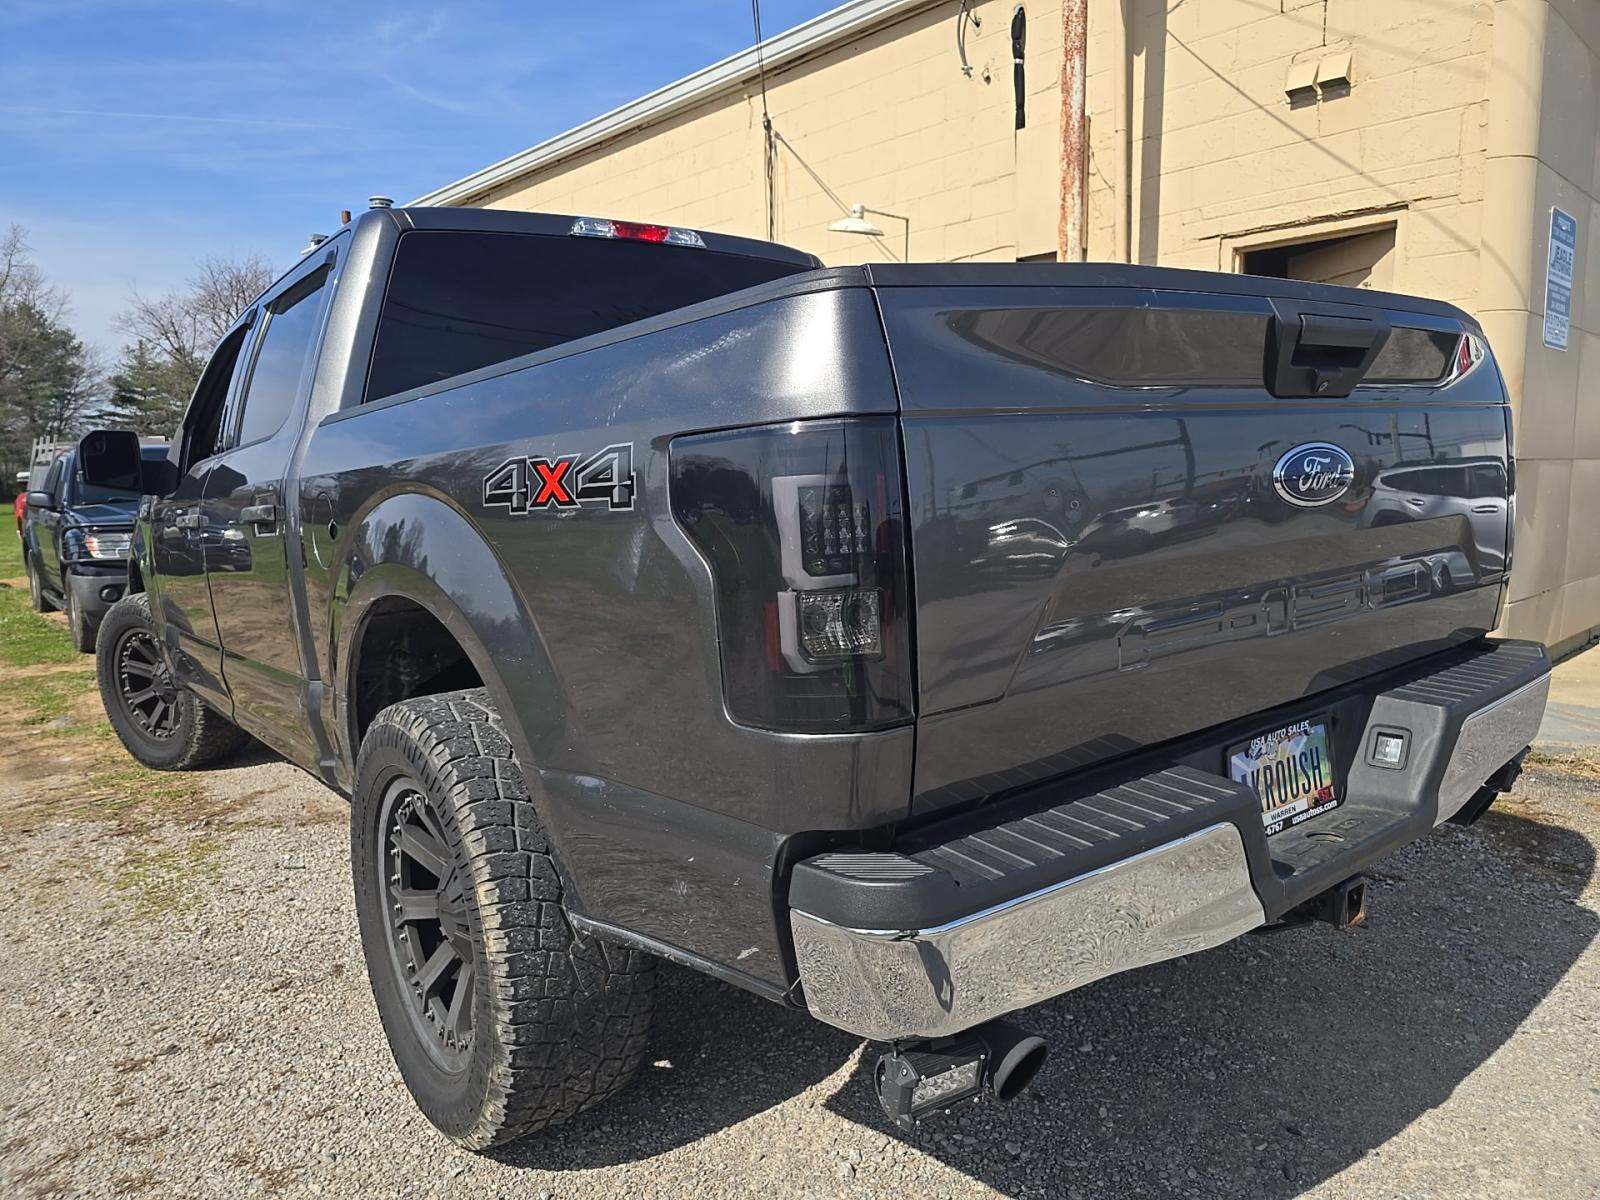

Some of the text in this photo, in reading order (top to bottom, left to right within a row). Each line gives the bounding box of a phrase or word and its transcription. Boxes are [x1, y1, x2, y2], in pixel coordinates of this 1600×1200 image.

[1299, 456, 1341, 492] Ford
[1118, 558, 1432, 673] F-150
[1250, 720, 1310, 749] USA AUTO SALES
[1241, 746, 1324, 812] KROUSH
[1271, 805, 1297, 821] WARREN
